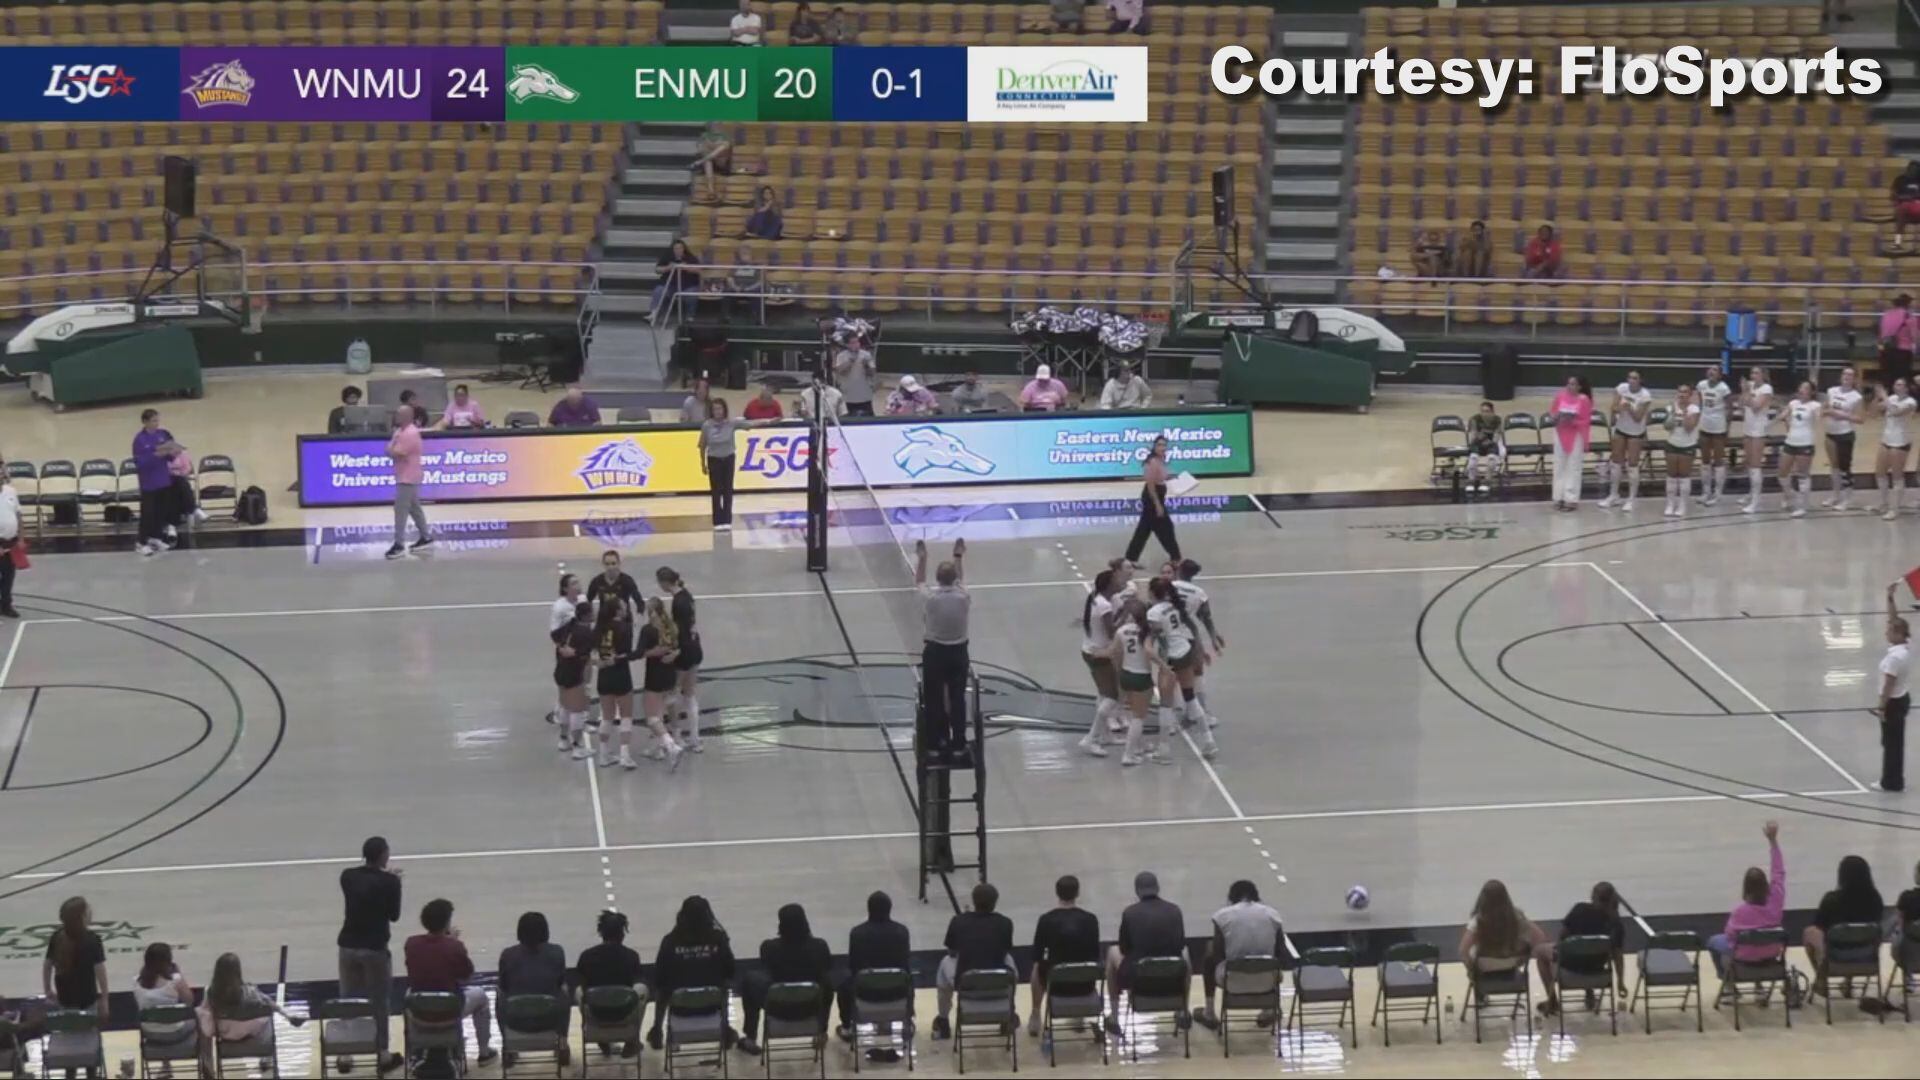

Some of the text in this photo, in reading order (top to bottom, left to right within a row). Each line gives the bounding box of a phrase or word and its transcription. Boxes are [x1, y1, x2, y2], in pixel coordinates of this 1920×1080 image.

[1056, 427, 1223, 445] Eastern New Mexico
[444, 450, 507, 465] Mexico
[1049, 445, 1231, 464] University Gyhounds
[331, 470, 507, 487] Univers Mustangs
[1170, 613, 1180, 629] 9
[1127, 638, 1137, 654] 2
